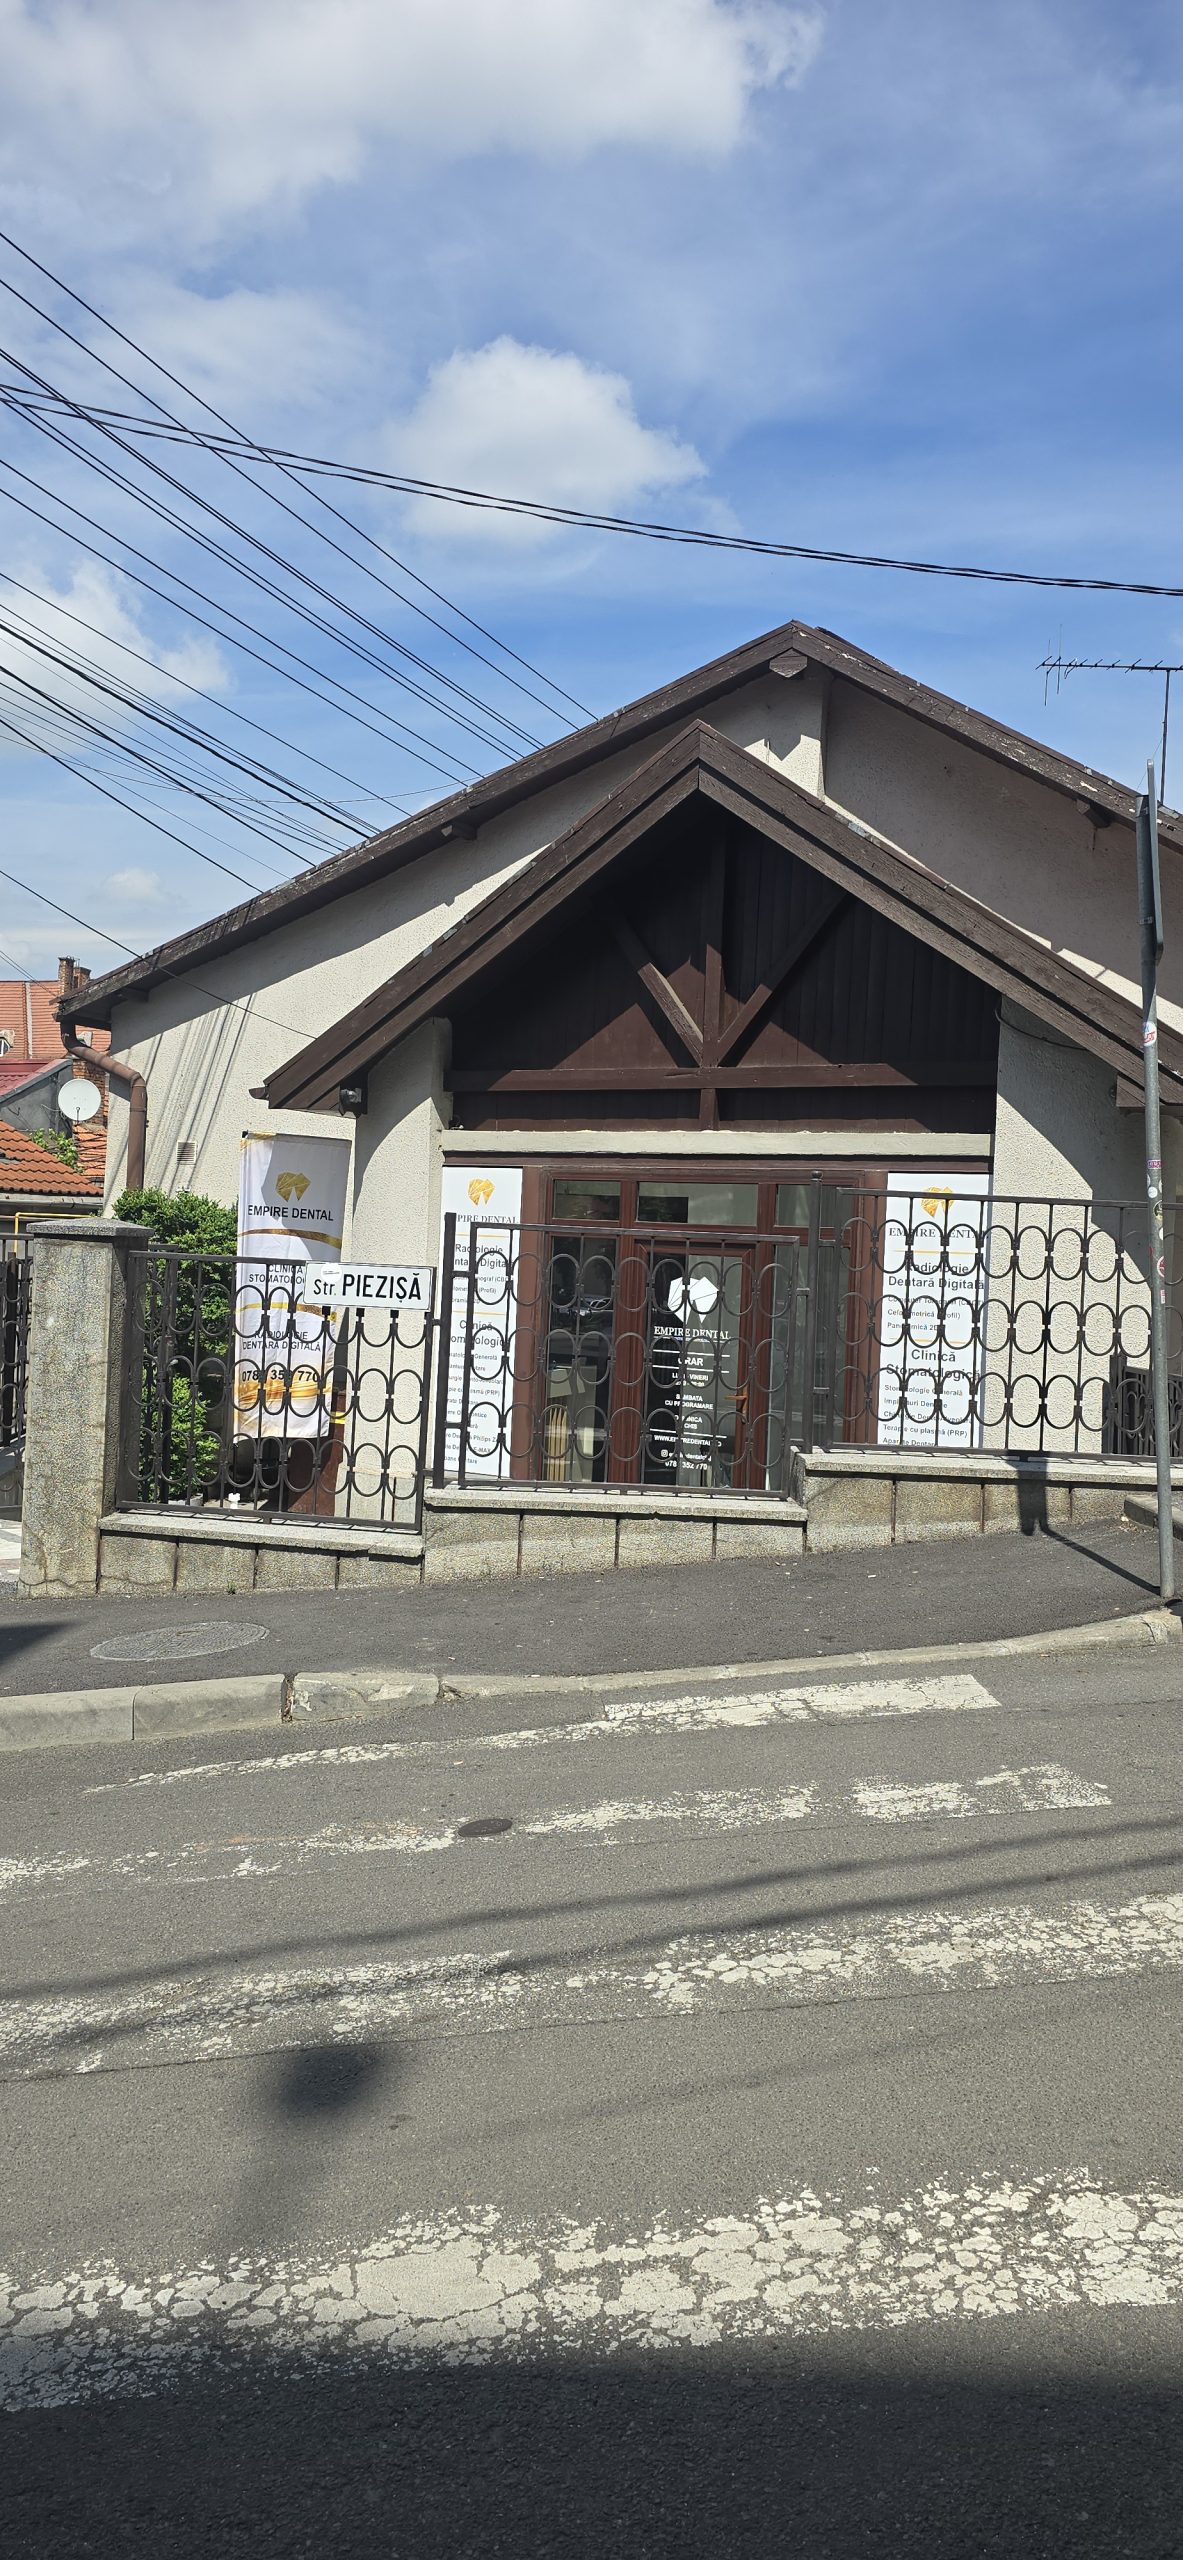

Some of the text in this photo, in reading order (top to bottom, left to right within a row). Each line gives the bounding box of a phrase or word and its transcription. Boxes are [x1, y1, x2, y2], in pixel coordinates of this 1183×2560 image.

[248, 1205, 334, 1221] EMPIRE DENTAL
[313, 1273, 421, 1303] Str. PIEZIȘĂ
[654, 1326, 691, 1337] EMPIRE
